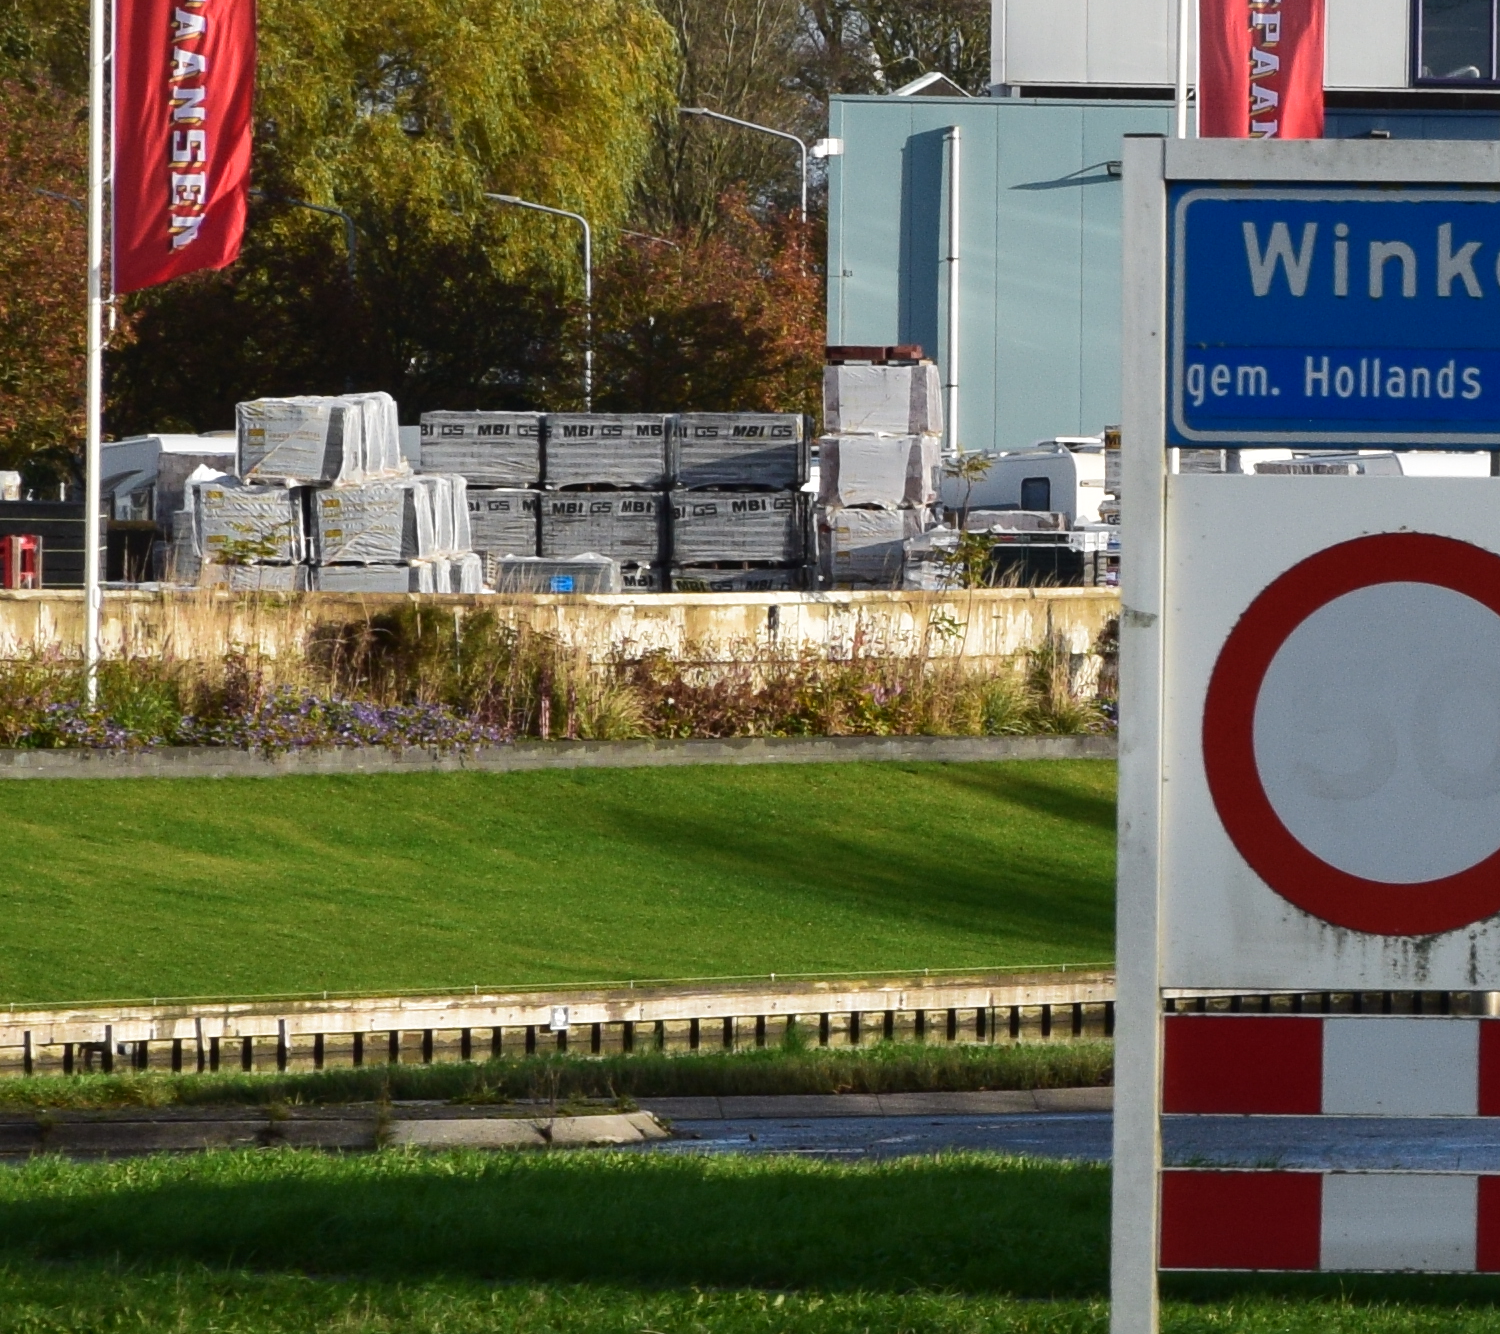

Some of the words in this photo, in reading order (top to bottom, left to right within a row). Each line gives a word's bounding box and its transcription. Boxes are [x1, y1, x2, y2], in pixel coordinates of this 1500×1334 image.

[1185, 362, 1280, 407] gem.
[1304, 355, 1481, 400] Hollands
[441, 424, 465, 436] GS
[477, 423, 510, 436] MBI
[562, 424, 595, 437] MBI
[600, 424, 624, 436] GS
[694, 425, 719, 438] GS
[732, 425, 764, 437] MBI
[770, 424, 793, 436] GS
[487, 499, 510, 511] GS
[552, 501, 583, 514] MBI
[589, 500, 613, 514] GS
[620, 500, 651, 513] MBI
[692, 503, 718, 517] GS
[731, 499, 766, 514] MBI
